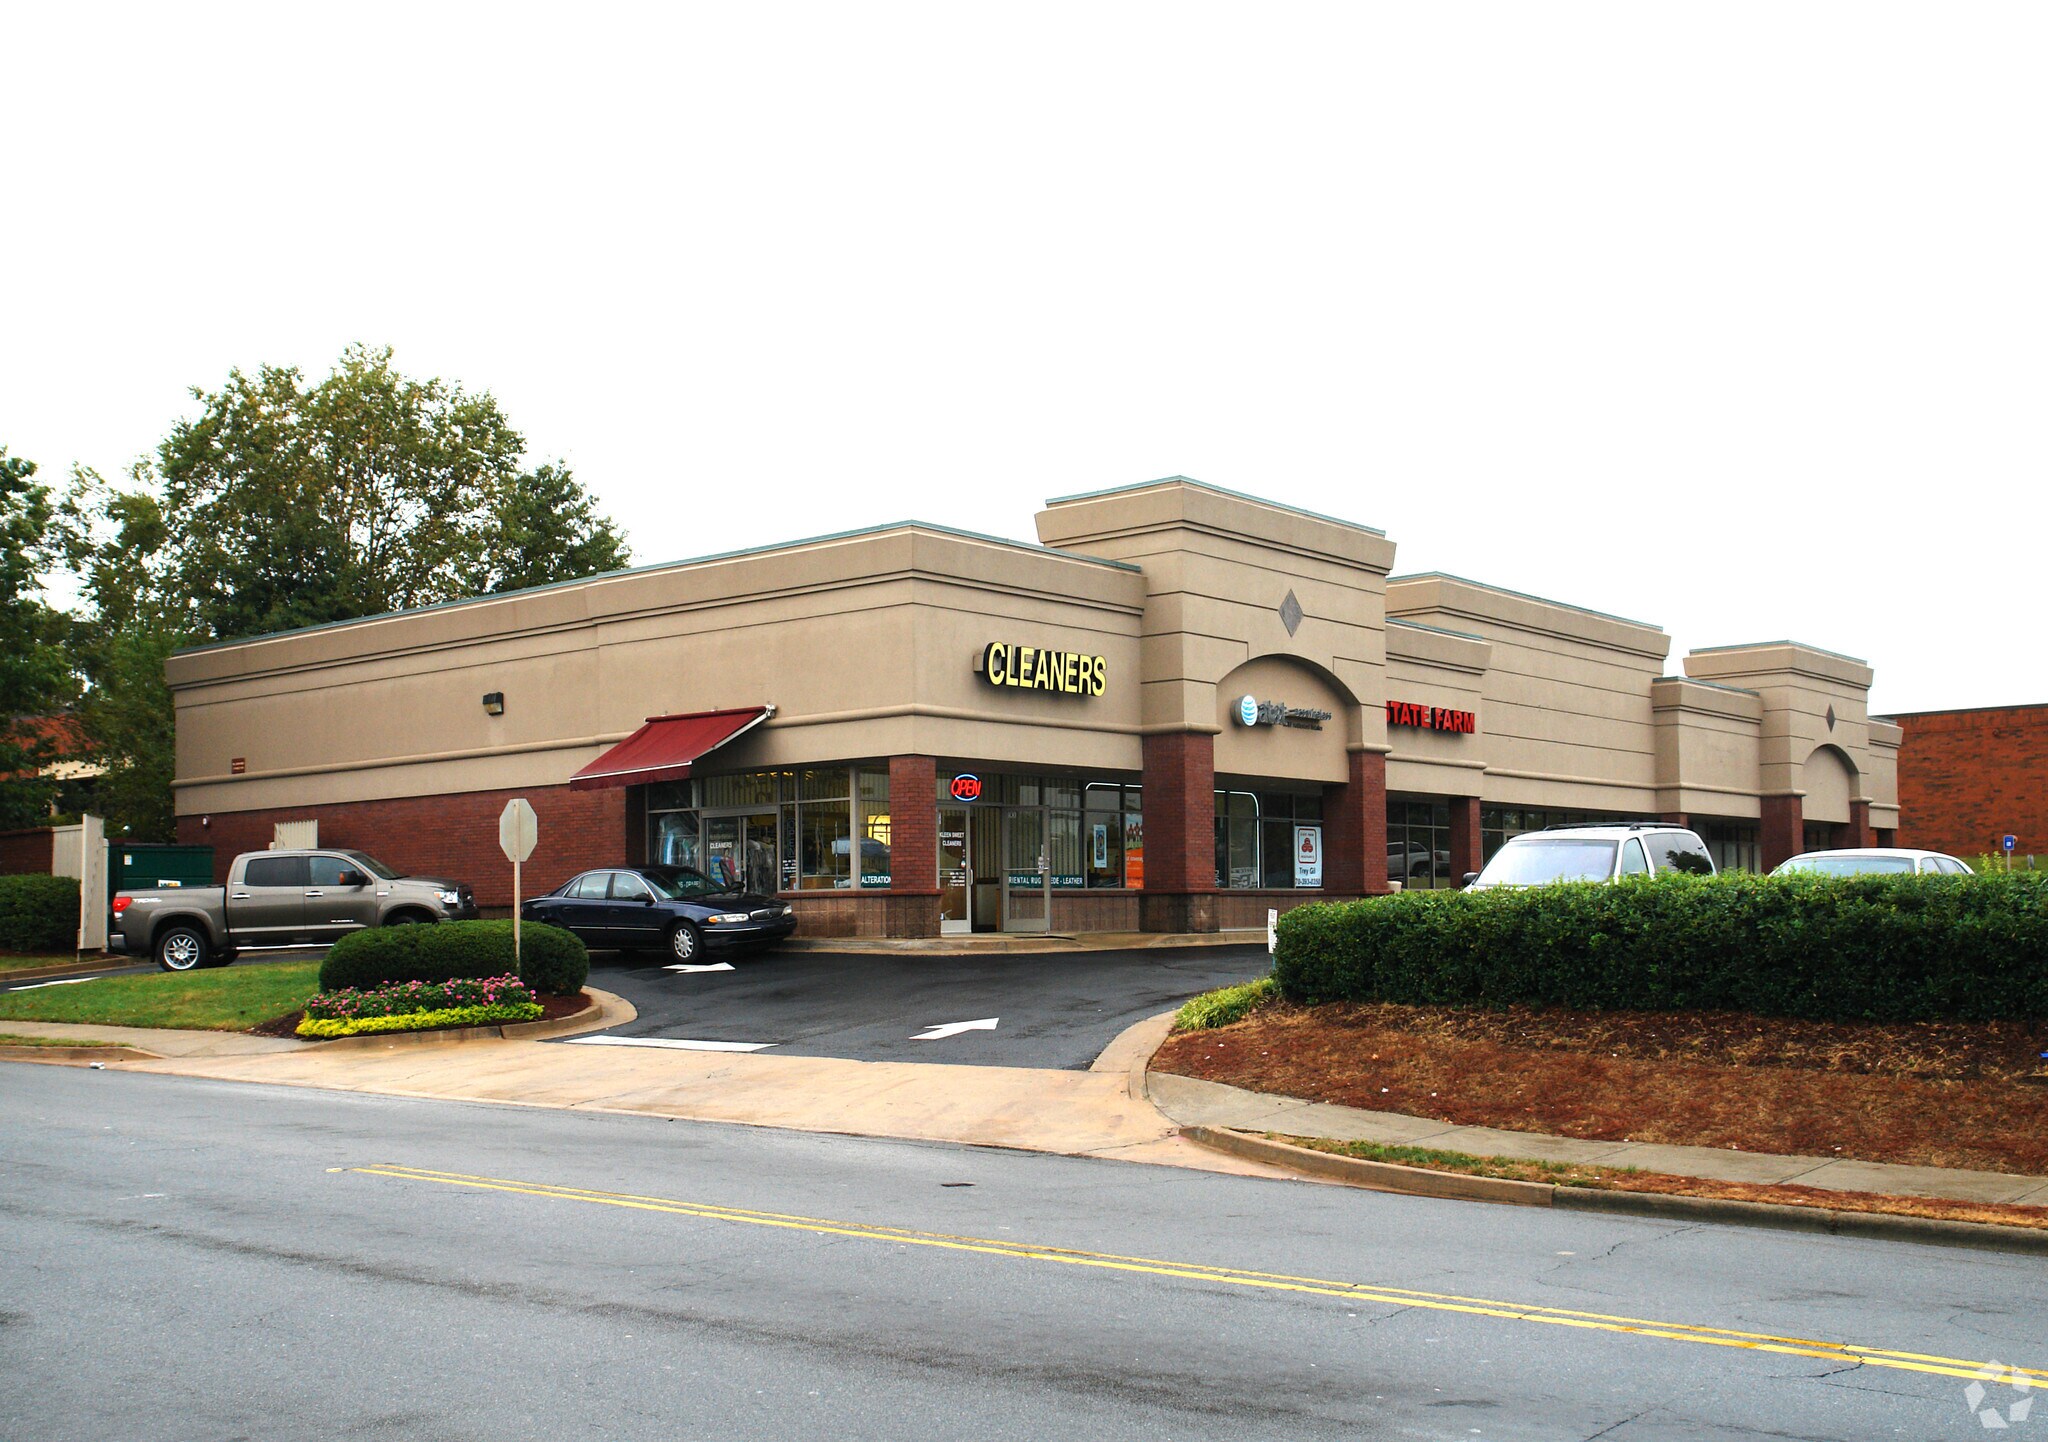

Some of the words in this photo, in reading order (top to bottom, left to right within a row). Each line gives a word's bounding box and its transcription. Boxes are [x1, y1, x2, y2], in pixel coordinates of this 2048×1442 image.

[985, 641, 1107, 697] CLEANERS
[1433, 707, 1475, 734] FARM
[951, 779, 982, 797] OPEN
[710, 841, 733, 849] CLEANERS
[1008, 876, 1030, 885] RIENTAL
[1063, 877, 1083, 885] LEATHER
